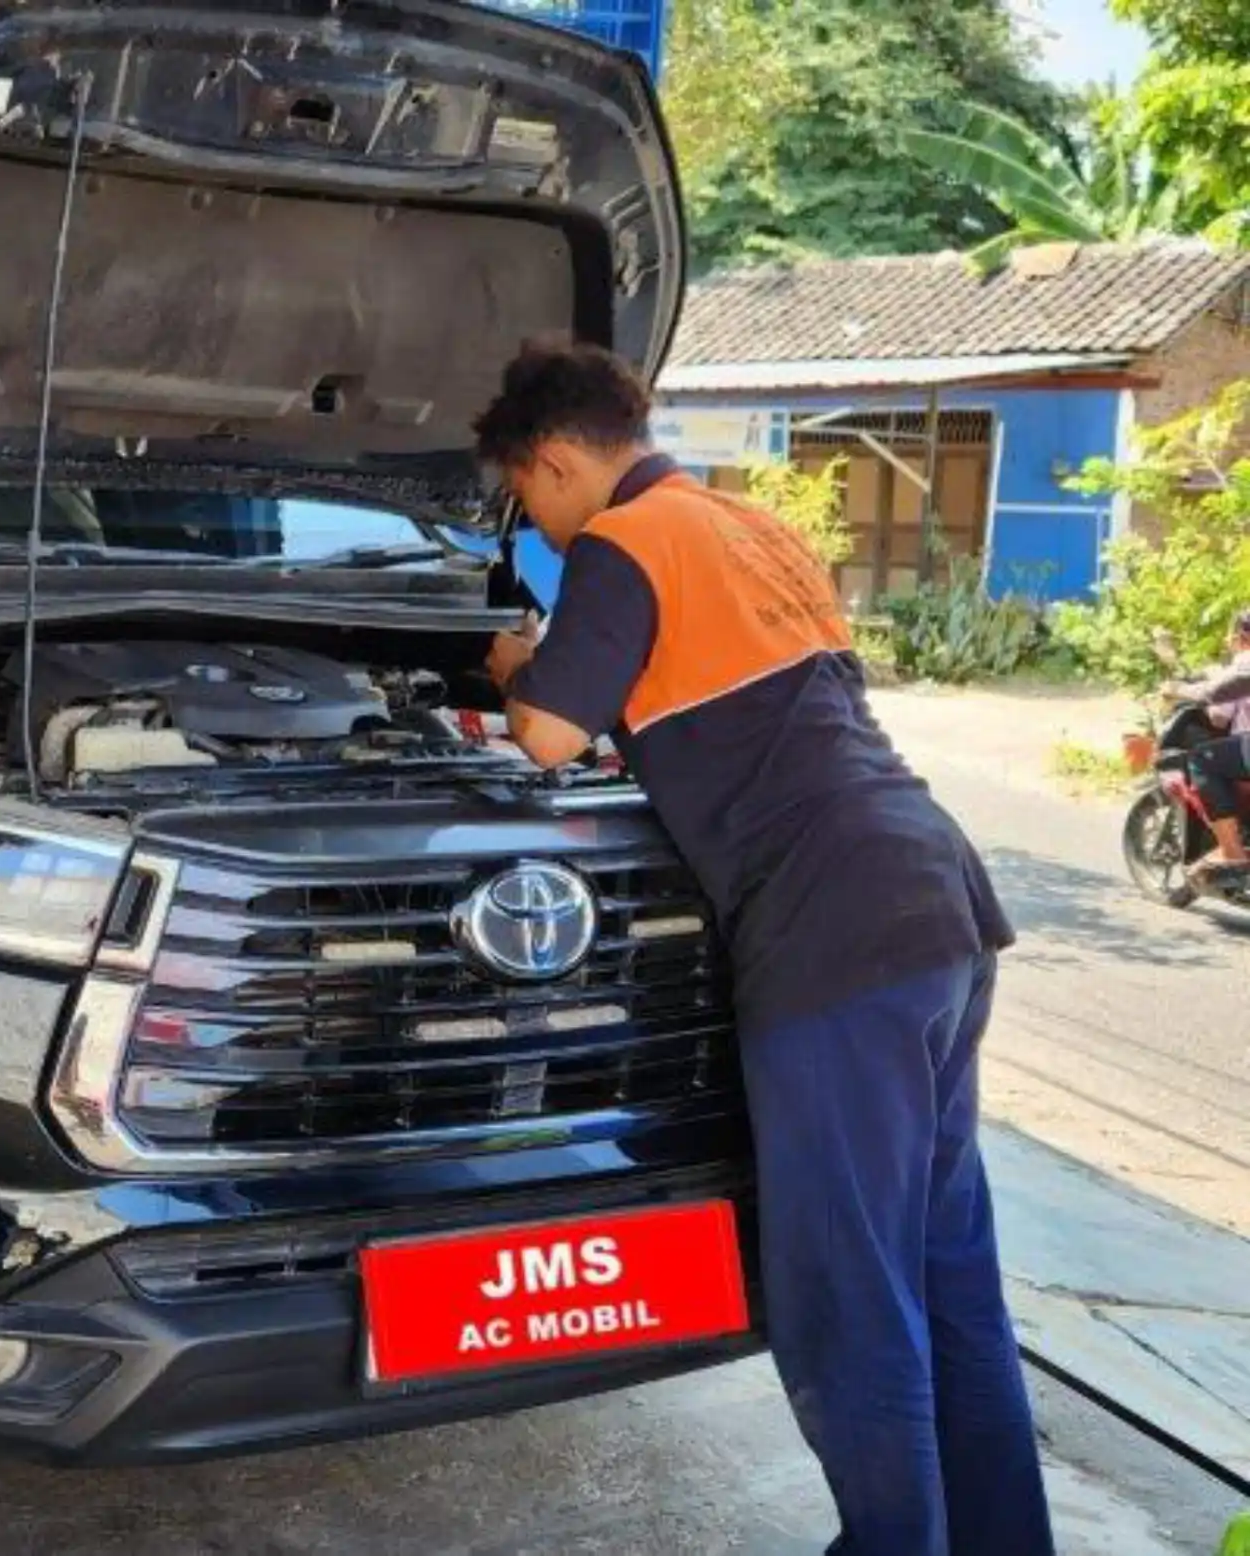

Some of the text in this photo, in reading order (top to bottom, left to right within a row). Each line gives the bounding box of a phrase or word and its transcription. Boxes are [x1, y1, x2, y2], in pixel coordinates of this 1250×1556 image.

[479, 1236, 623, 1299] JMS
[458, 1299, 661, 1353] AC MOBIL
